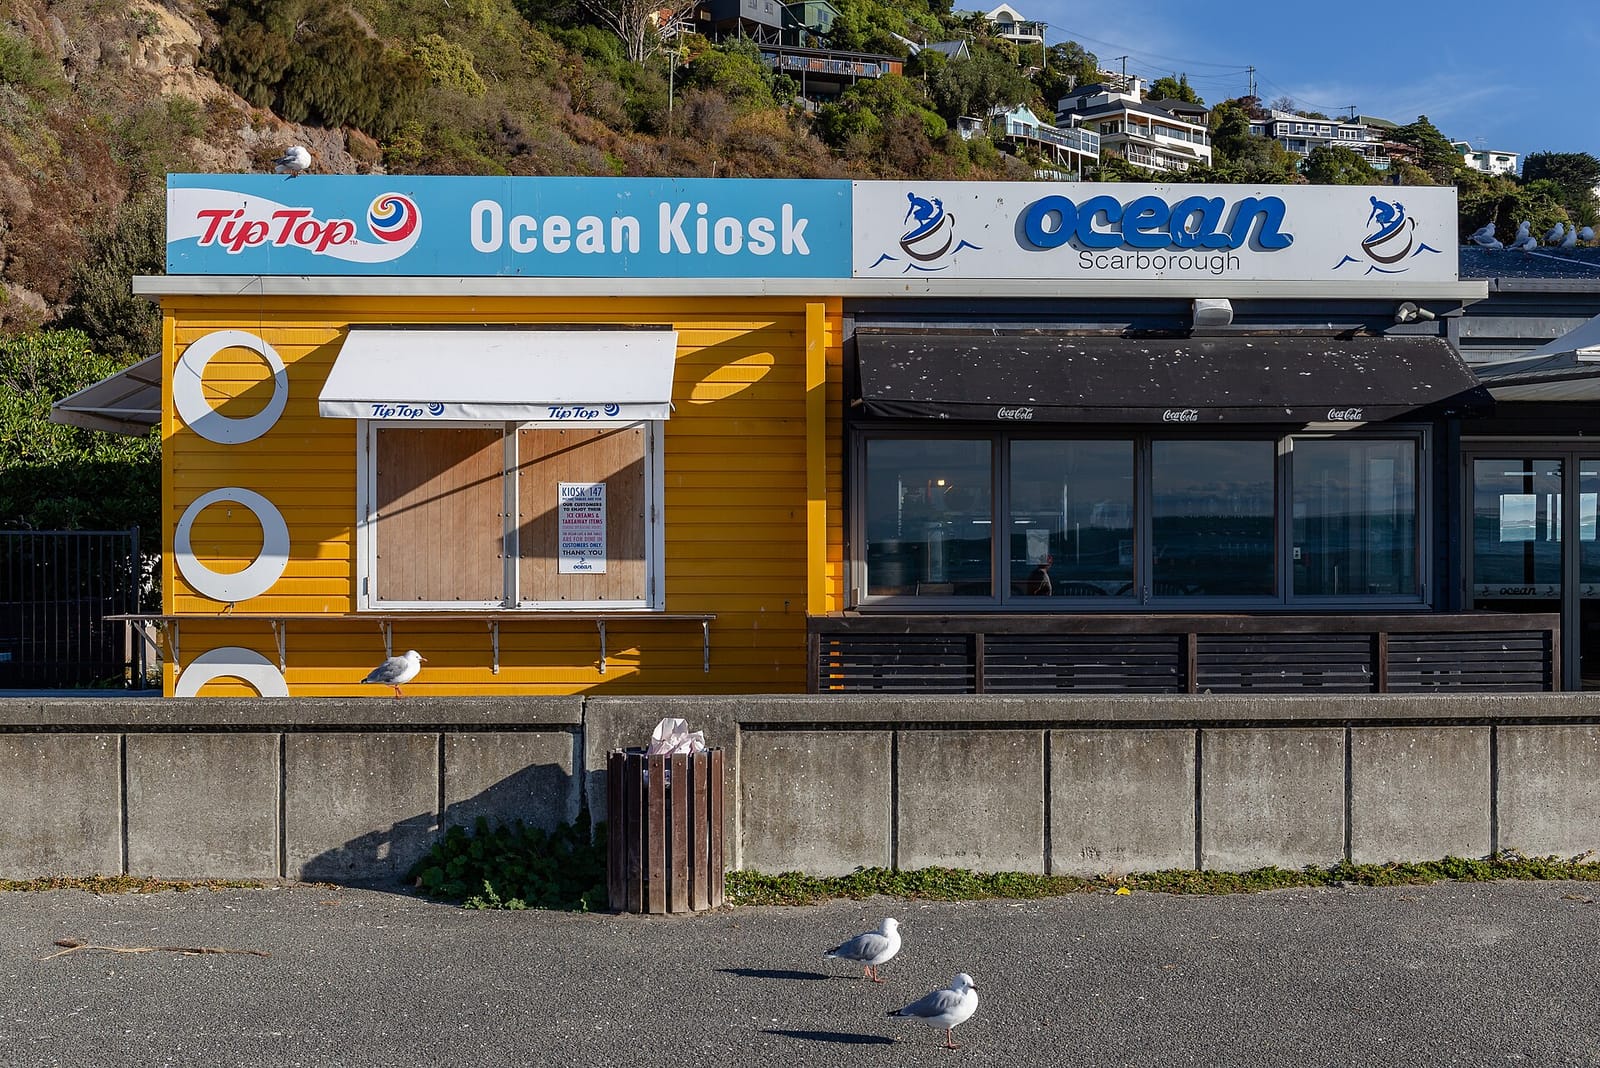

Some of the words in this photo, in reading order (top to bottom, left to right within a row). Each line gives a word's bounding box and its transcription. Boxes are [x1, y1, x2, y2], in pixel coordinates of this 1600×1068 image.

[197, 208, 270, 252] Tip
[272, 209, 354, 252] Top
[470, 199, 640, 255] Ocean
[658, 201, 811, 256] Kiosk
[1018, 193, 1295, 252] ocean
[1078, 249, 1241, 275] Scarborough
[561, 486, 586, 497] KIOSK
[589, 487, 603, 497] 147
[1499, 586, 1537, 596] ocean
